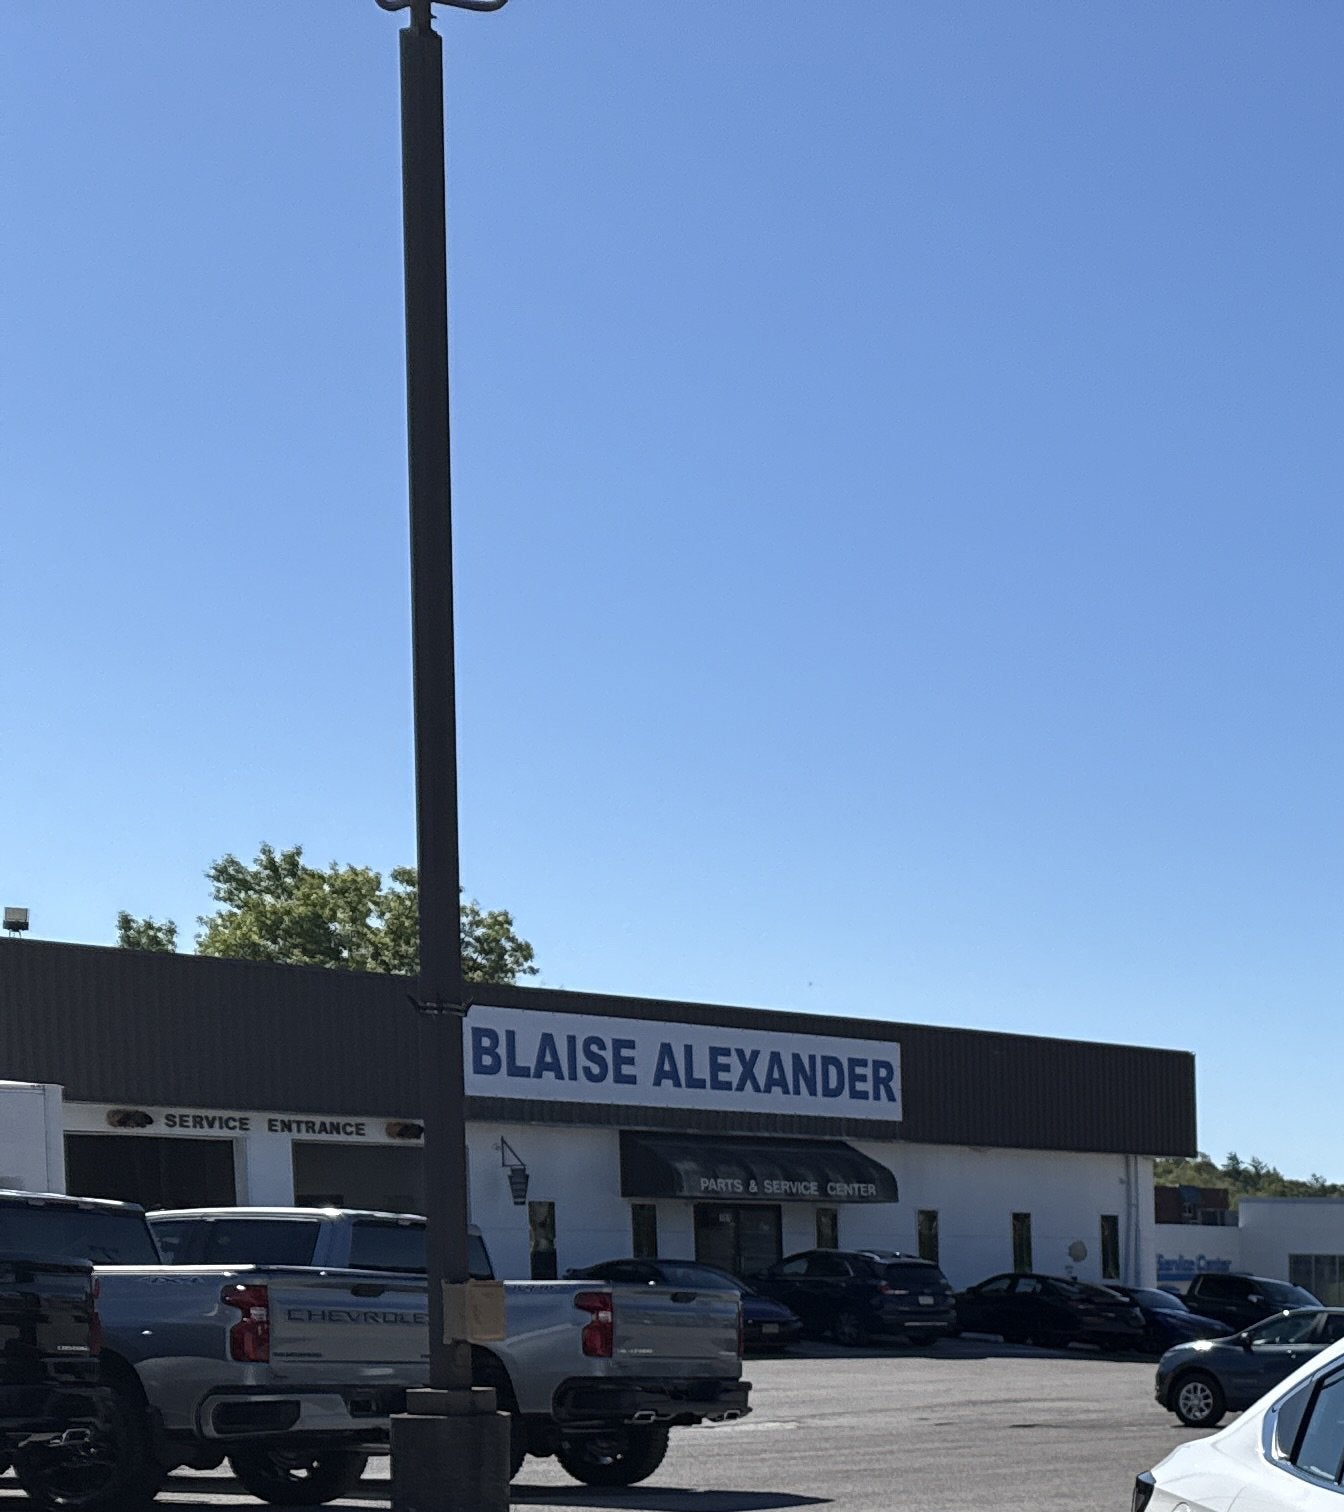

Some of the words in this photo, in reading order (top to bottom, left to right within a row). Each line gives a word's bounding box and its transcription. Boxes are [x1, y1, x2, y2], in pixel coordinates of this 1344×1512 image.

[470, 1026, 638, 1085] BLAISE
[652, 1041, 898, 1103] ALEXANDER
[164, 1113, 250, 1131] SERVICE
[267, 1117, 366, 1136] ENTRANCE
[700, 1178, 743, 1193] PARTS
[749, 1179, 759, 1193] &
[764, 1179, 819, 1196] SERVICE
[827, 1182, 877, 1197] CENTER
